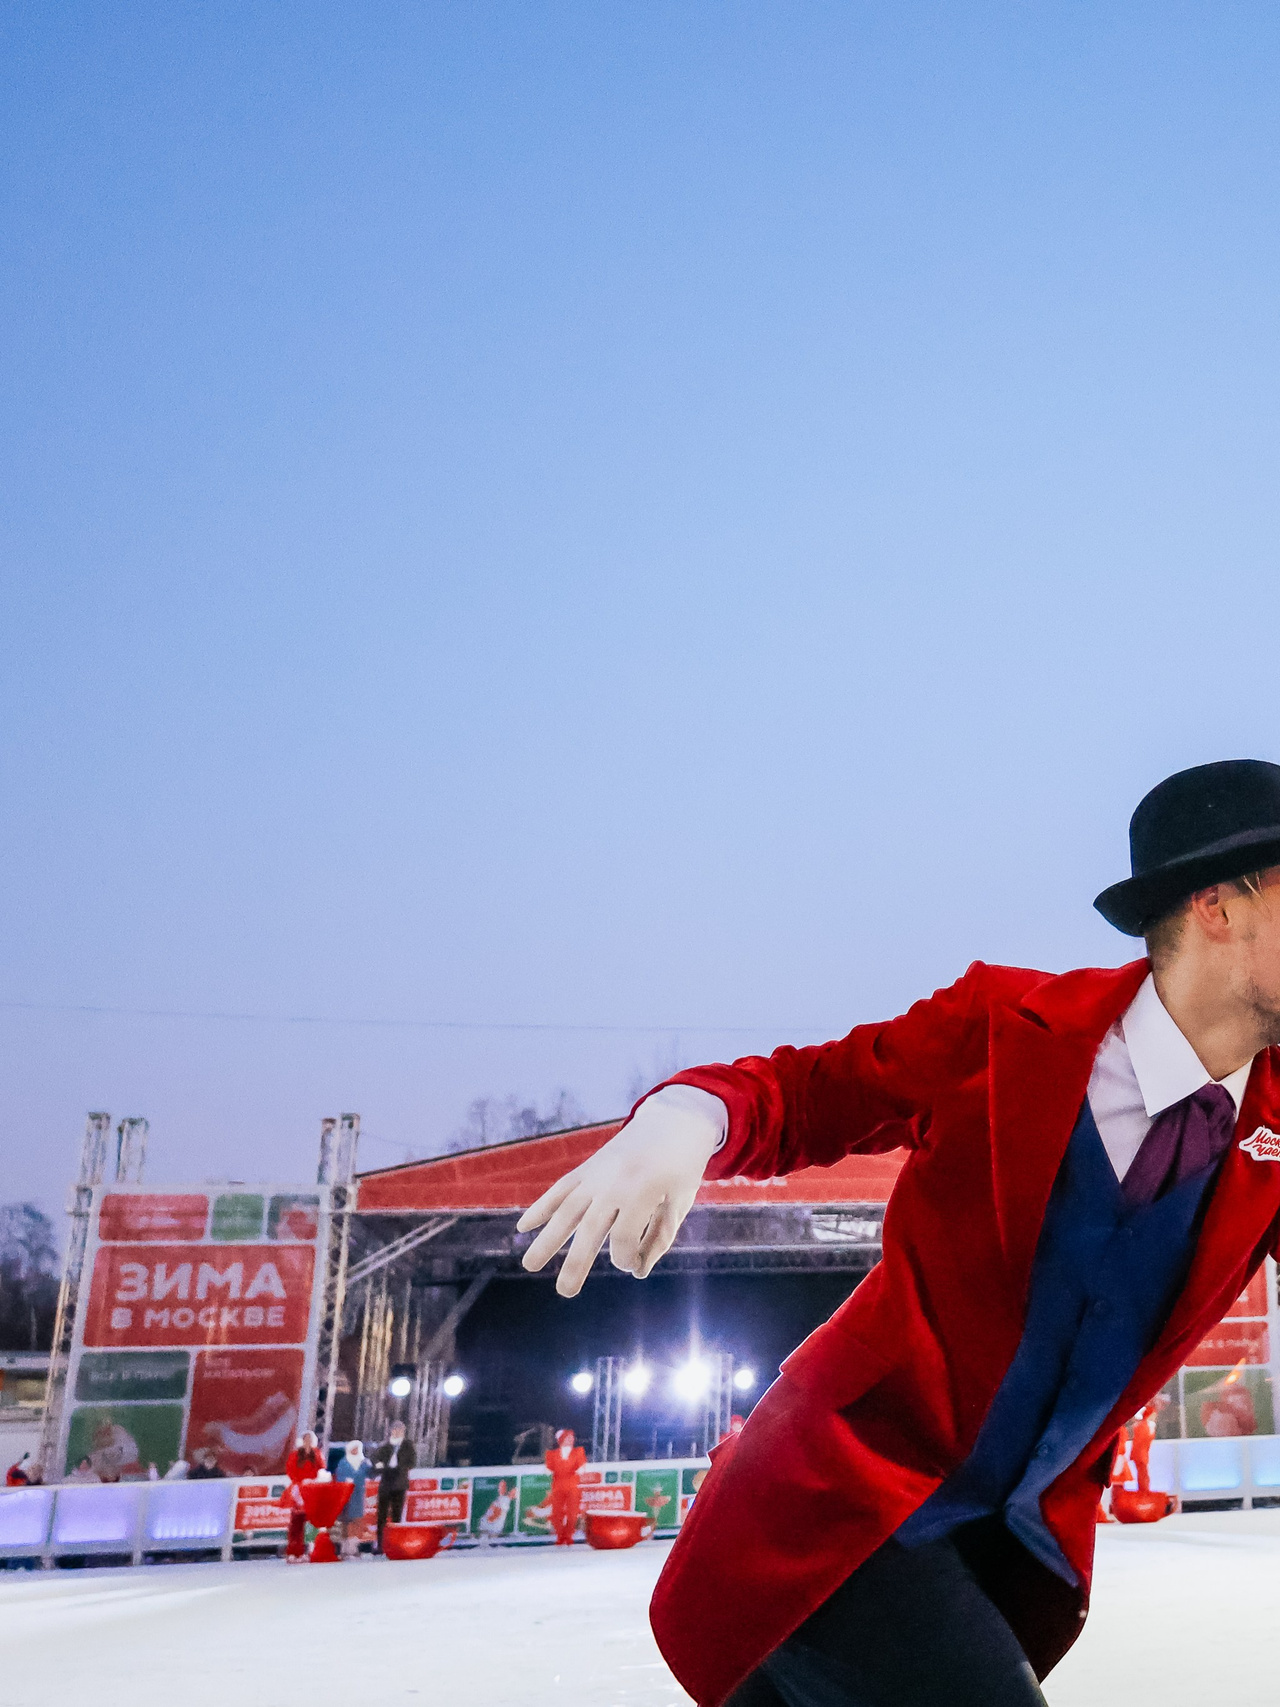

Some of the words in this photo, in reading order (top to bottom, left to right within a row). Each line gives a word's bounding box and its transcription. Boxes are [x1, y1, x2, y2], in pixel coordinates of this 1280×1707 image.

[115, 1262, 287, 1301] ЗИМА
[110, 1307, 133, 1329] В
[144, 1305, 286, 1328] МОСКВЕ
